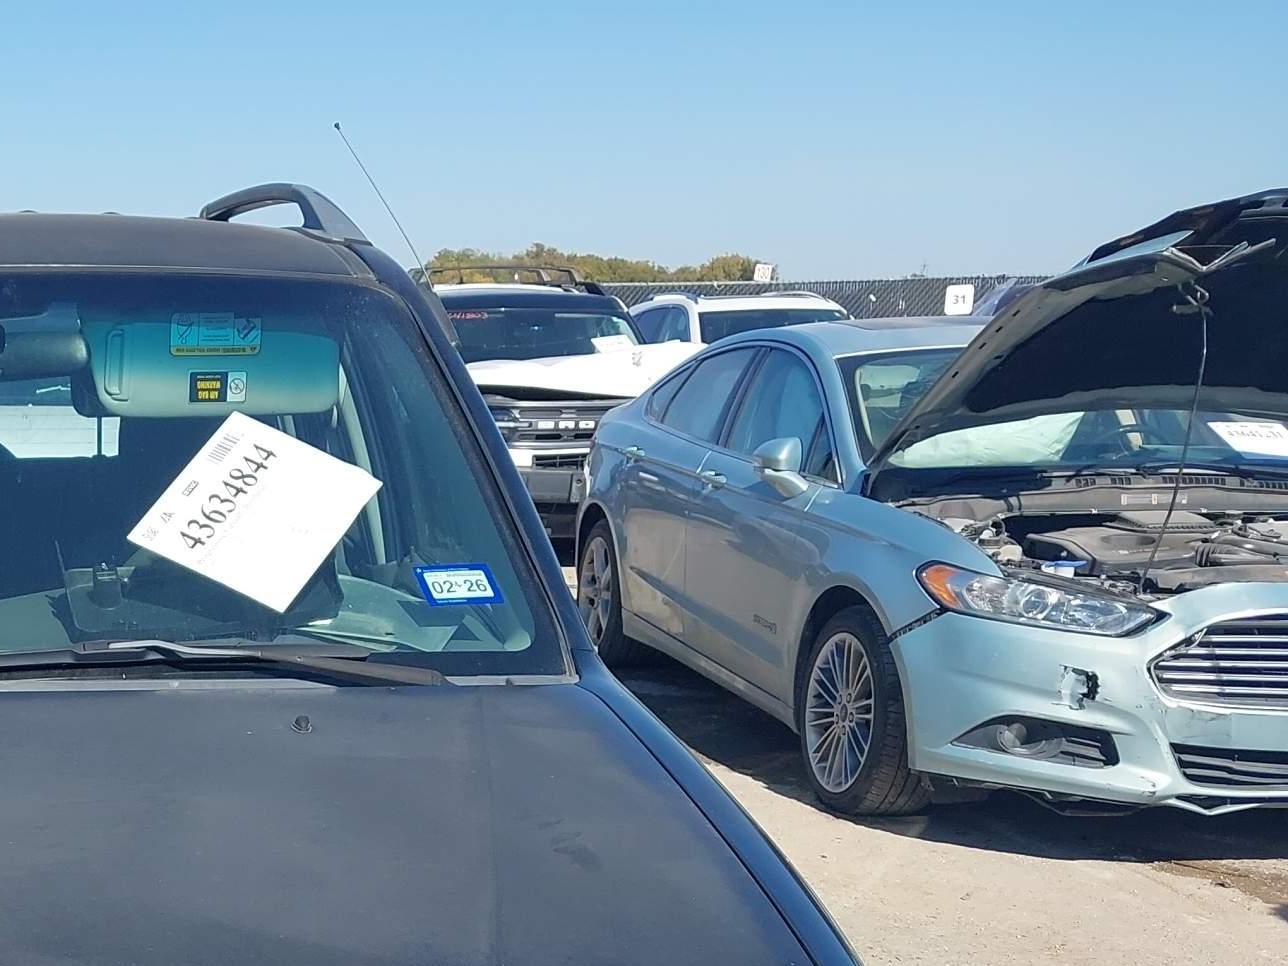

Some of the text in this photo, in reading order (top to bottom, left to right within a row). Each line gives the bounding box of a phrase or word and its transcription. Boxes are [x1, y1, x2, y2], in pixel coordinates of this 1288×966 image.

[952, 294, 966, 305] 31
[537, 420, 596, 430] BRO
[179, 443, 277, 549] 43634844
